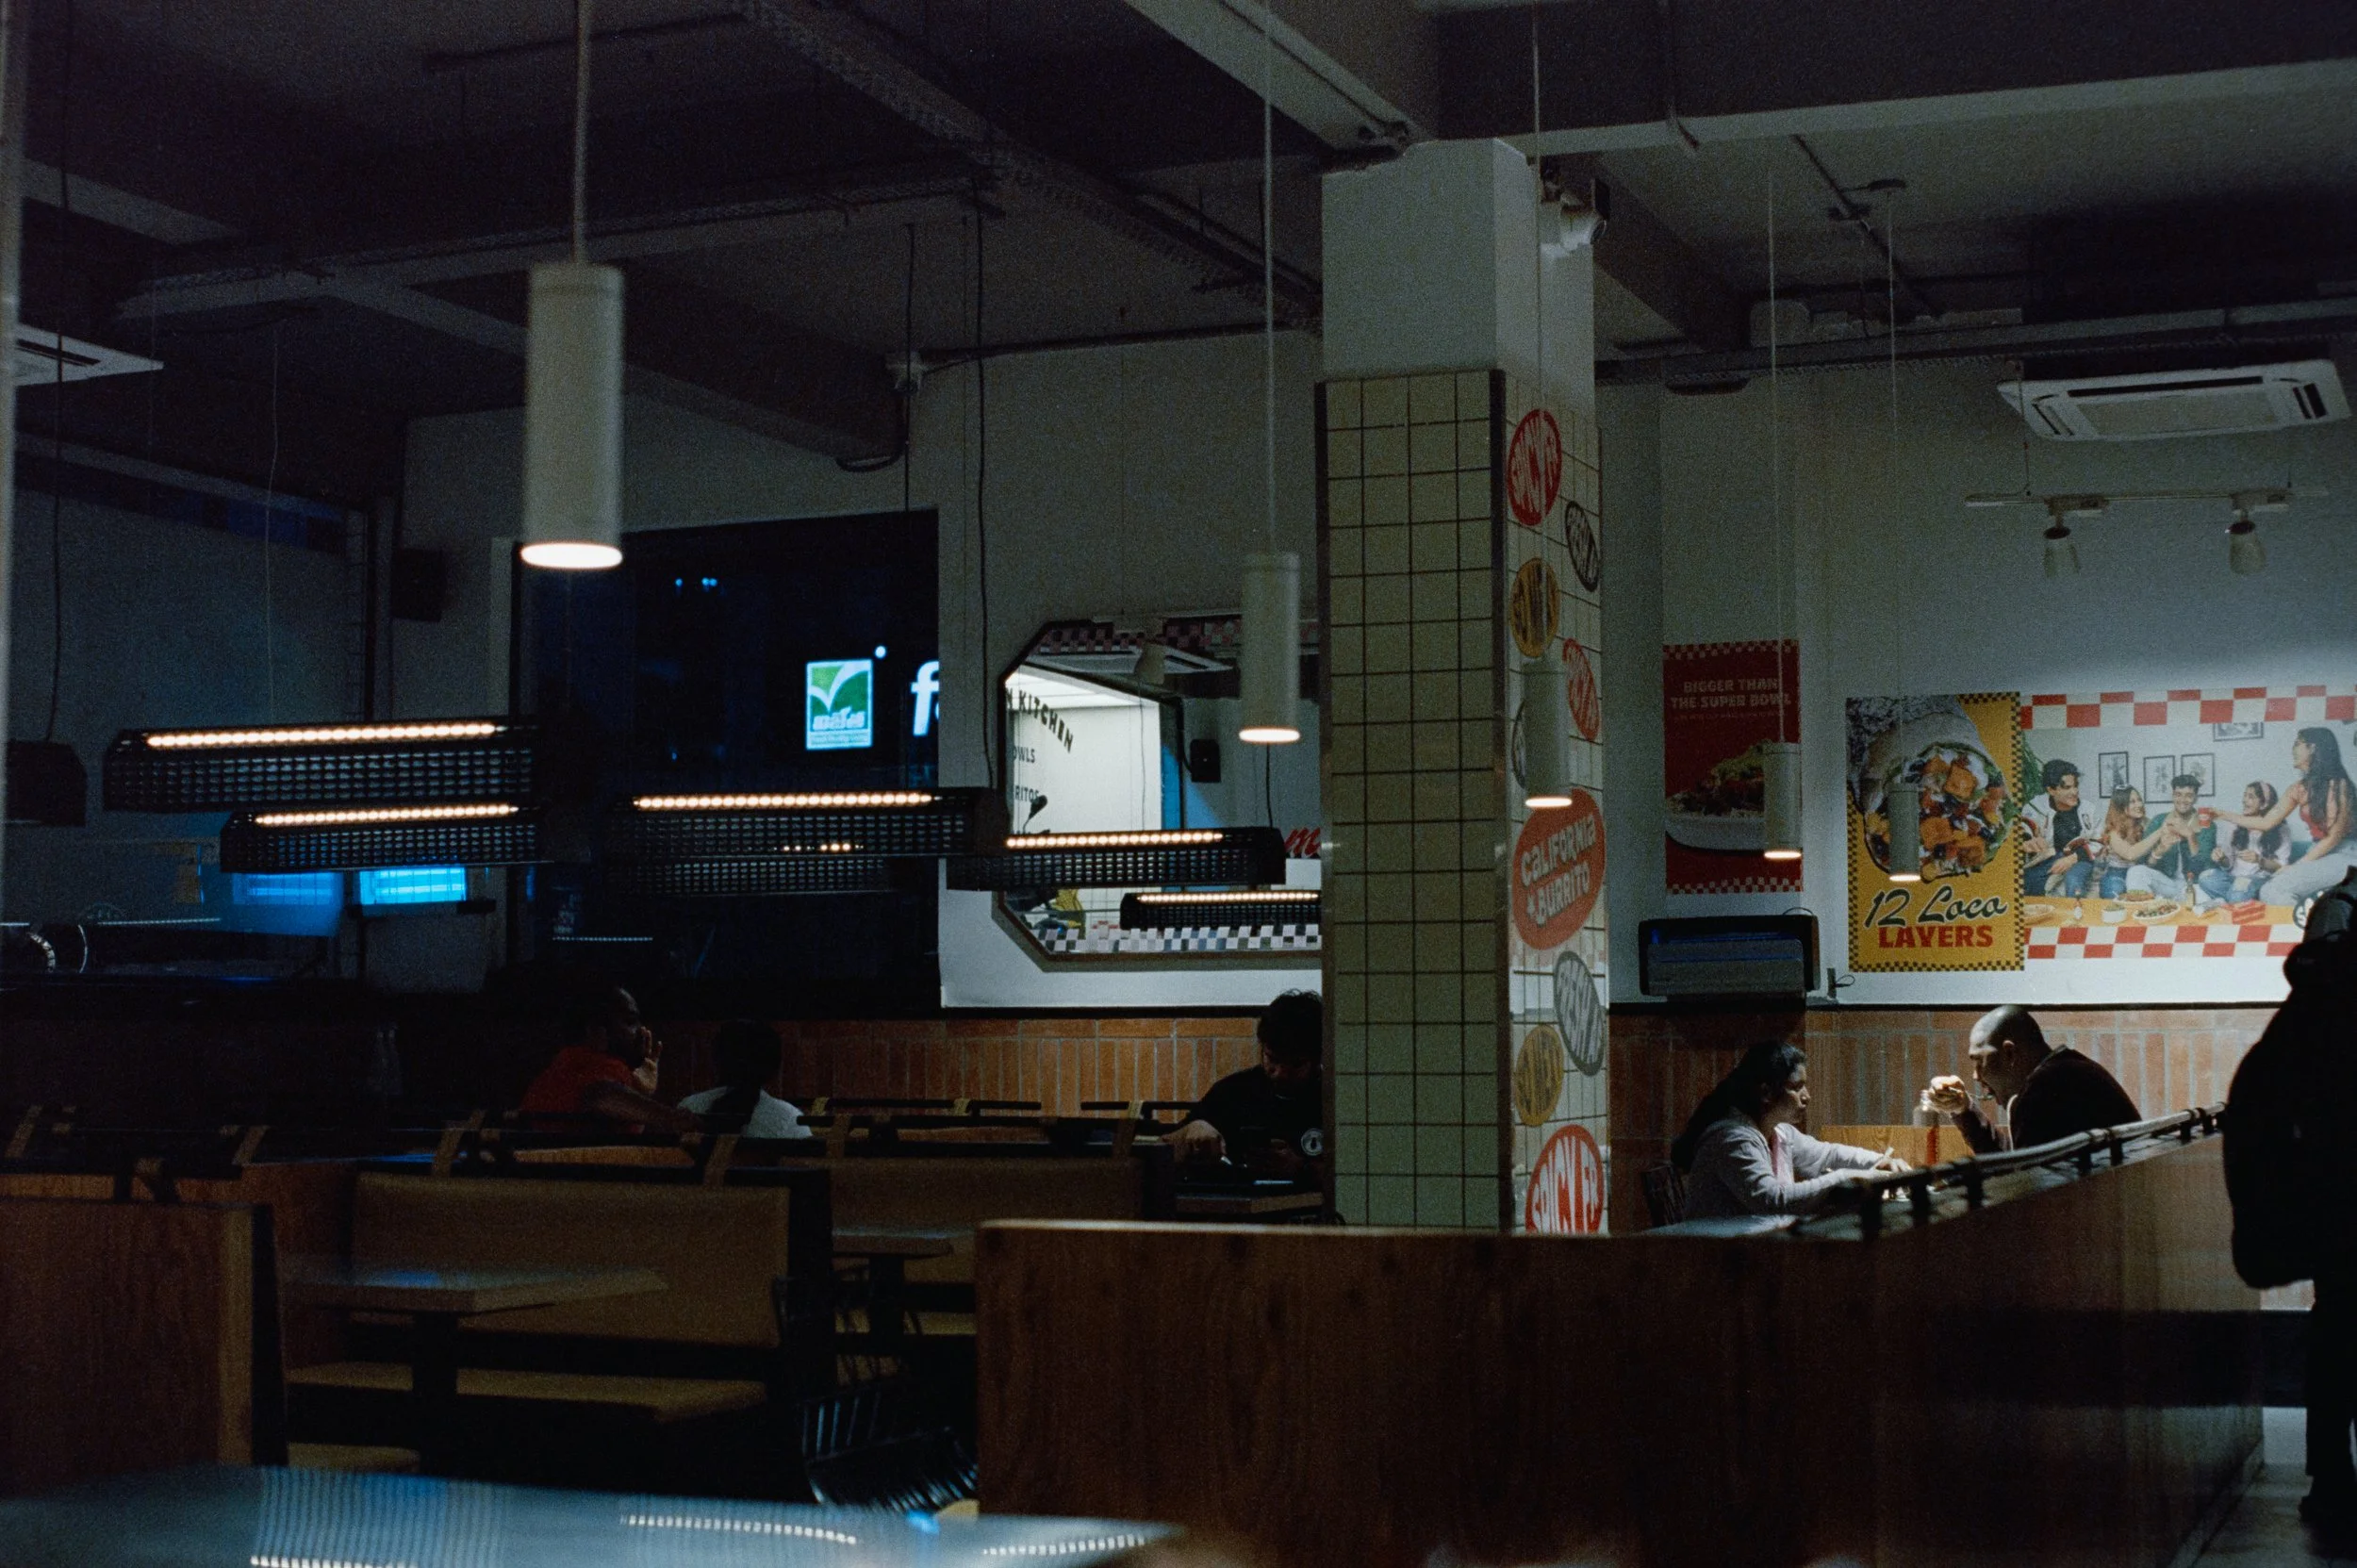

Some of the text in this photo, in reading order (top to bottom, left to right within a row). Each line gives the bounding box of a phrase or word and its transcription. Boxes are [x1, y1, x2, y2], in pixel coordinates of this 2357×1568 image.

[1670, 692, 1791, 709] THE SUPER BOWL
[1683, 677, 1779, 693] BIGGER THAN
[1018, 689, 1073, 753] KITCHEN
[1012, 744, 1035, 764] OWLS
[1521, 814, 1596, 887] CALIFORNIA
[1536, 860, 1591, 926] BURRITO
[1864, 883, 2009, 929] 12 Loco
[1879, 924, 1994, 949] LAYERS
